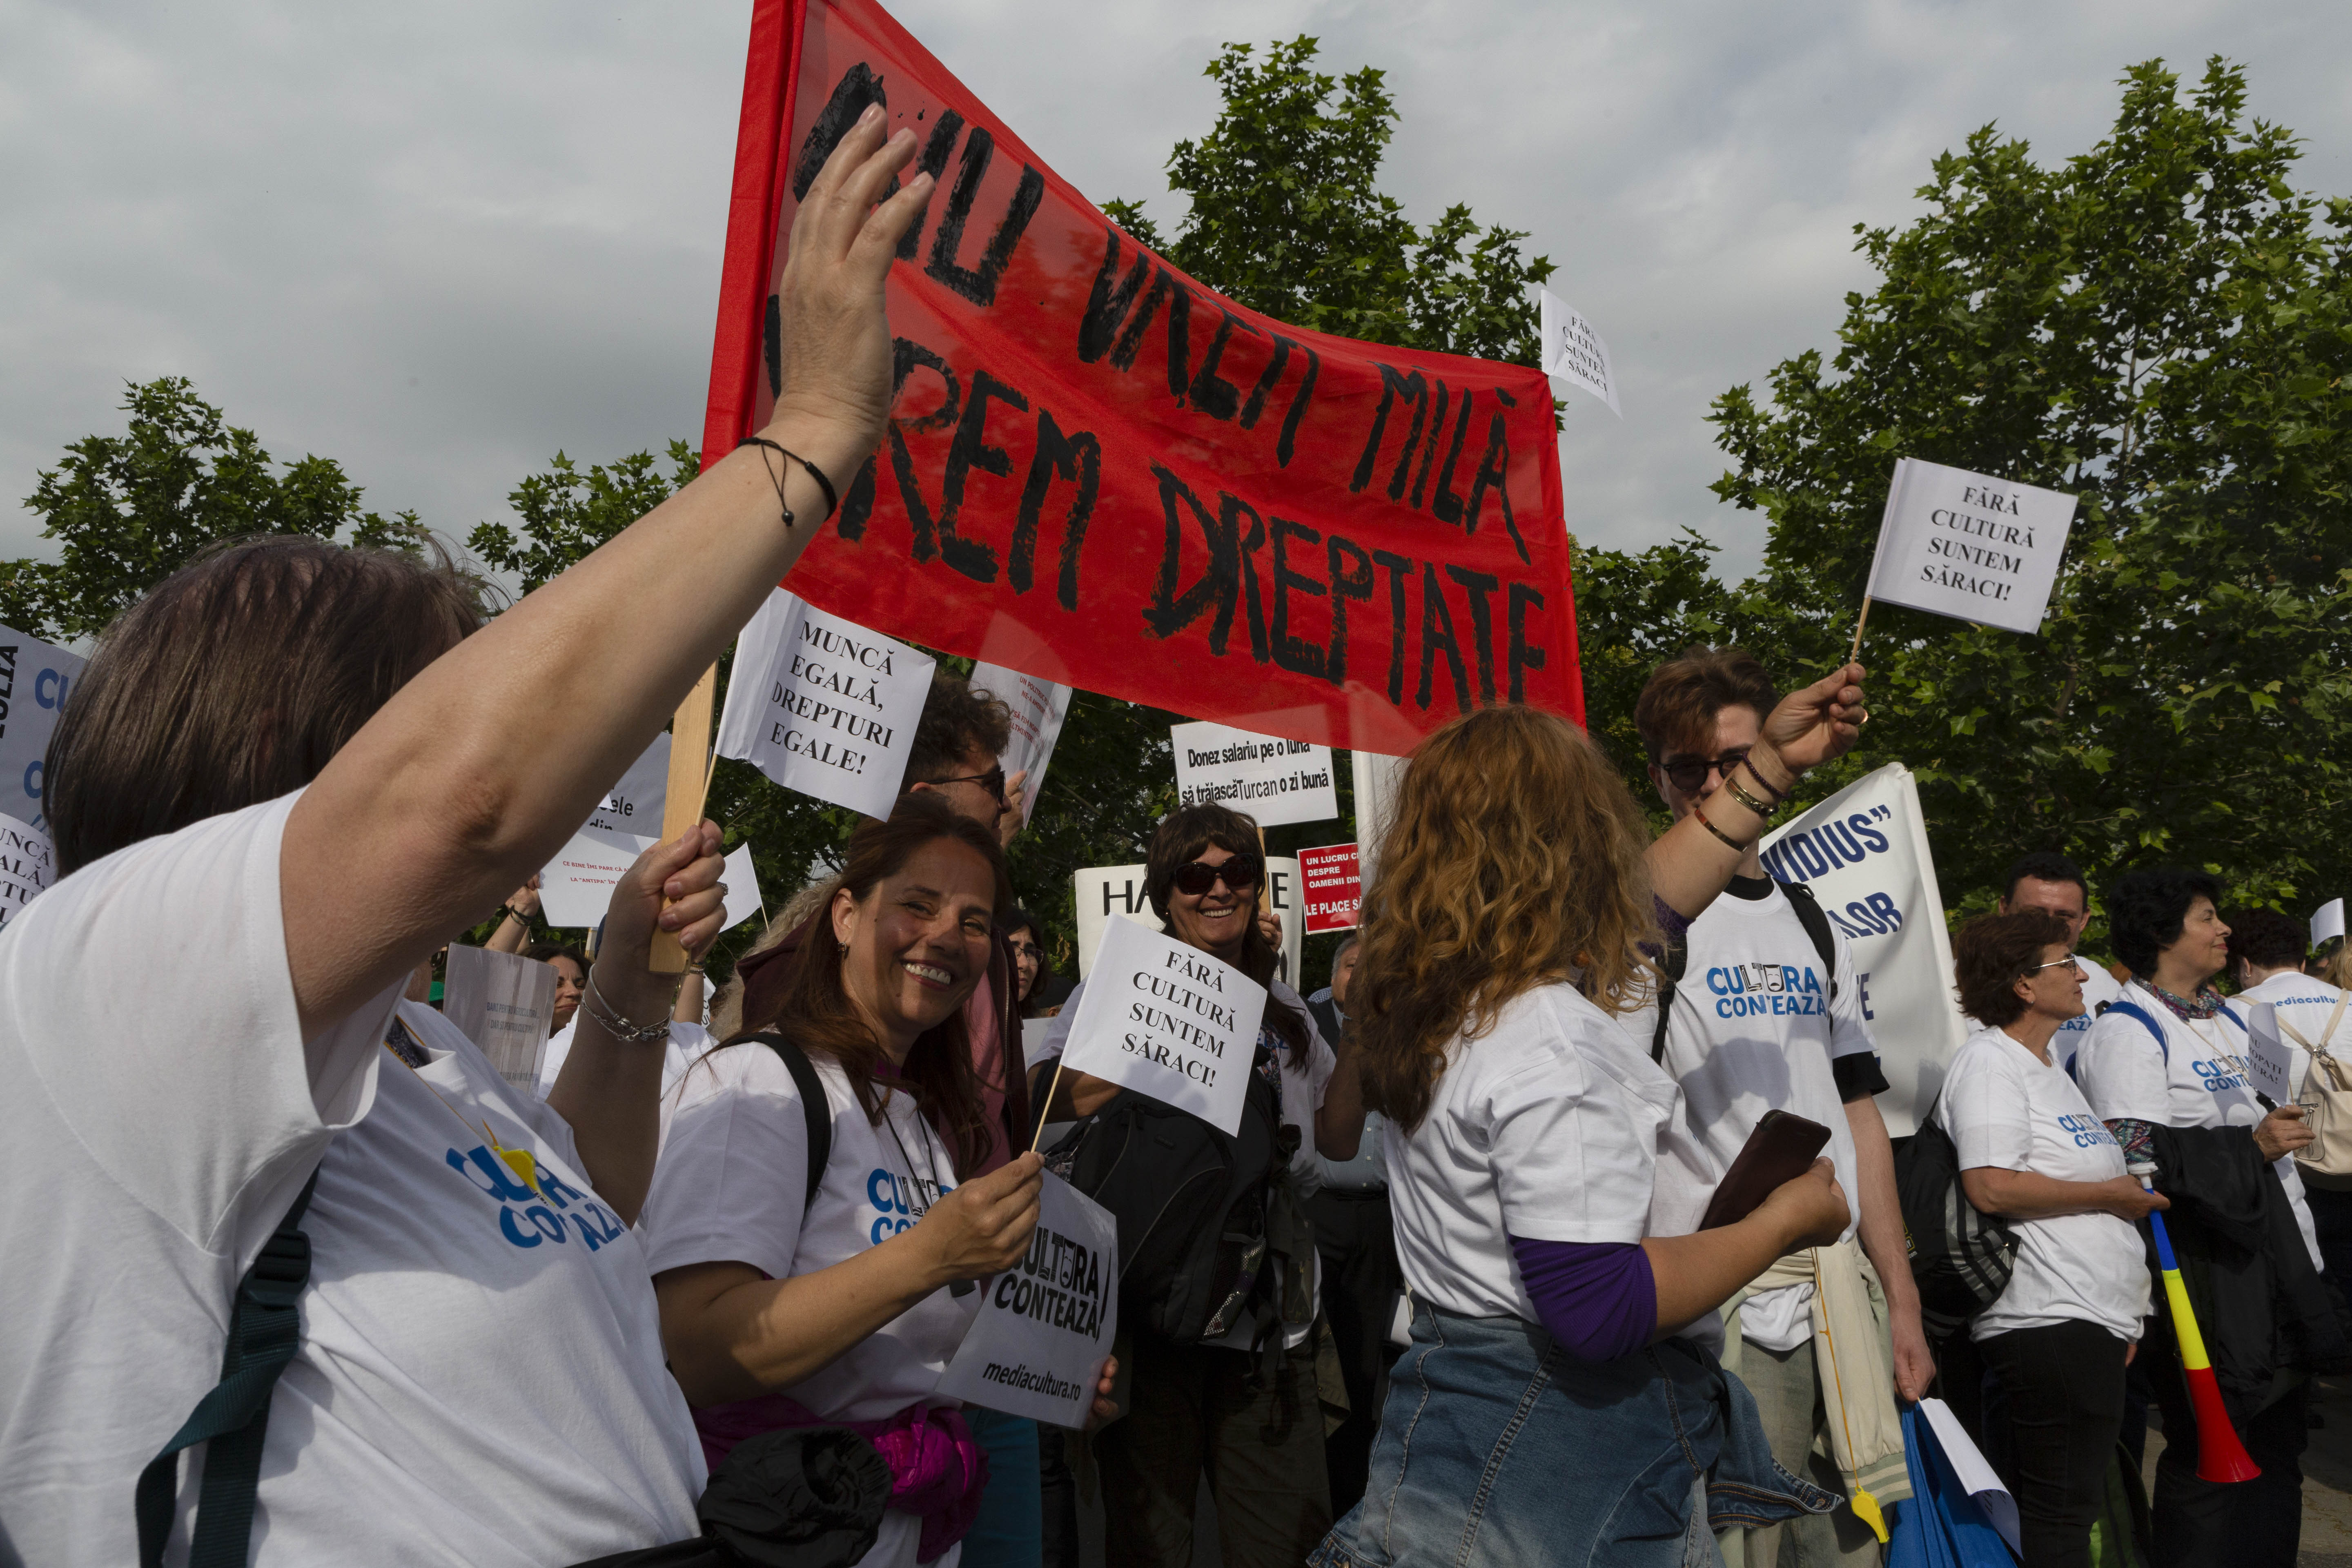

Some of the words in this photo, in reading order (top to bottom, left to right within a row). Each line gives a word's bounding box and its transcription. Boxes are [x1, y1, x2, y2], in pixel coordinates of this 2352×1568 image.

[1962, 486, 2020, 516] FĂRĂ
[1931, 509, 2035, 548] CULTURĂ
[1928, 537, 2022, 574] SUNTEM
[1920, 564, 2011, 601] SĂRACI!
[798, 620, 895, 676] MUNCĂ
[789, 654, 883, 712] EGALĂ,
[772, 681, 895, 748] DREPTURI
[770, 722, 866, 774] EGALE!
[1187, 748, 1221, 768] Donez
[1222, 741, 1258, 763] salariu
[1261, 742, 1274, 763] pe
[1276, 741, 1284, 756] o
[1182, 784, 1195, 804] să
[1196, 778, 1238, 803] trăiască
[1236, 779, 1278, 800] Turcan
[1279, 777, 1287, 792] o
[1289, 771, 1299, 791] zi
[1301, 767, 1329, 790] bună
[599, 796, 633, 816] ele
[1306, 857, 1319, 865] UN
[1321, 853, 1349, 864] LUCRU
[1307, 866, 1340, 877] DESPRE
[1309, 878, 1345, 888] OAMENII
[1305, 904, 1318, 916] LE
[1319, 900, 1350, 915] PLACE
[1165, 950, 1225, 993] FĂRĂ
[1133, 971, 1236, 1033] CULTURĂ
[2274, 996, 2339, 1008] ediacultu
[1129, 1002, 1226, 1059] SUNTEM
[1121, 1033, 1216, 1087] SĂRACI!
[1010, 1226, 1099, 1300] ULTURA
[982, 1362, 1081, 1401] mediacultura.ro
